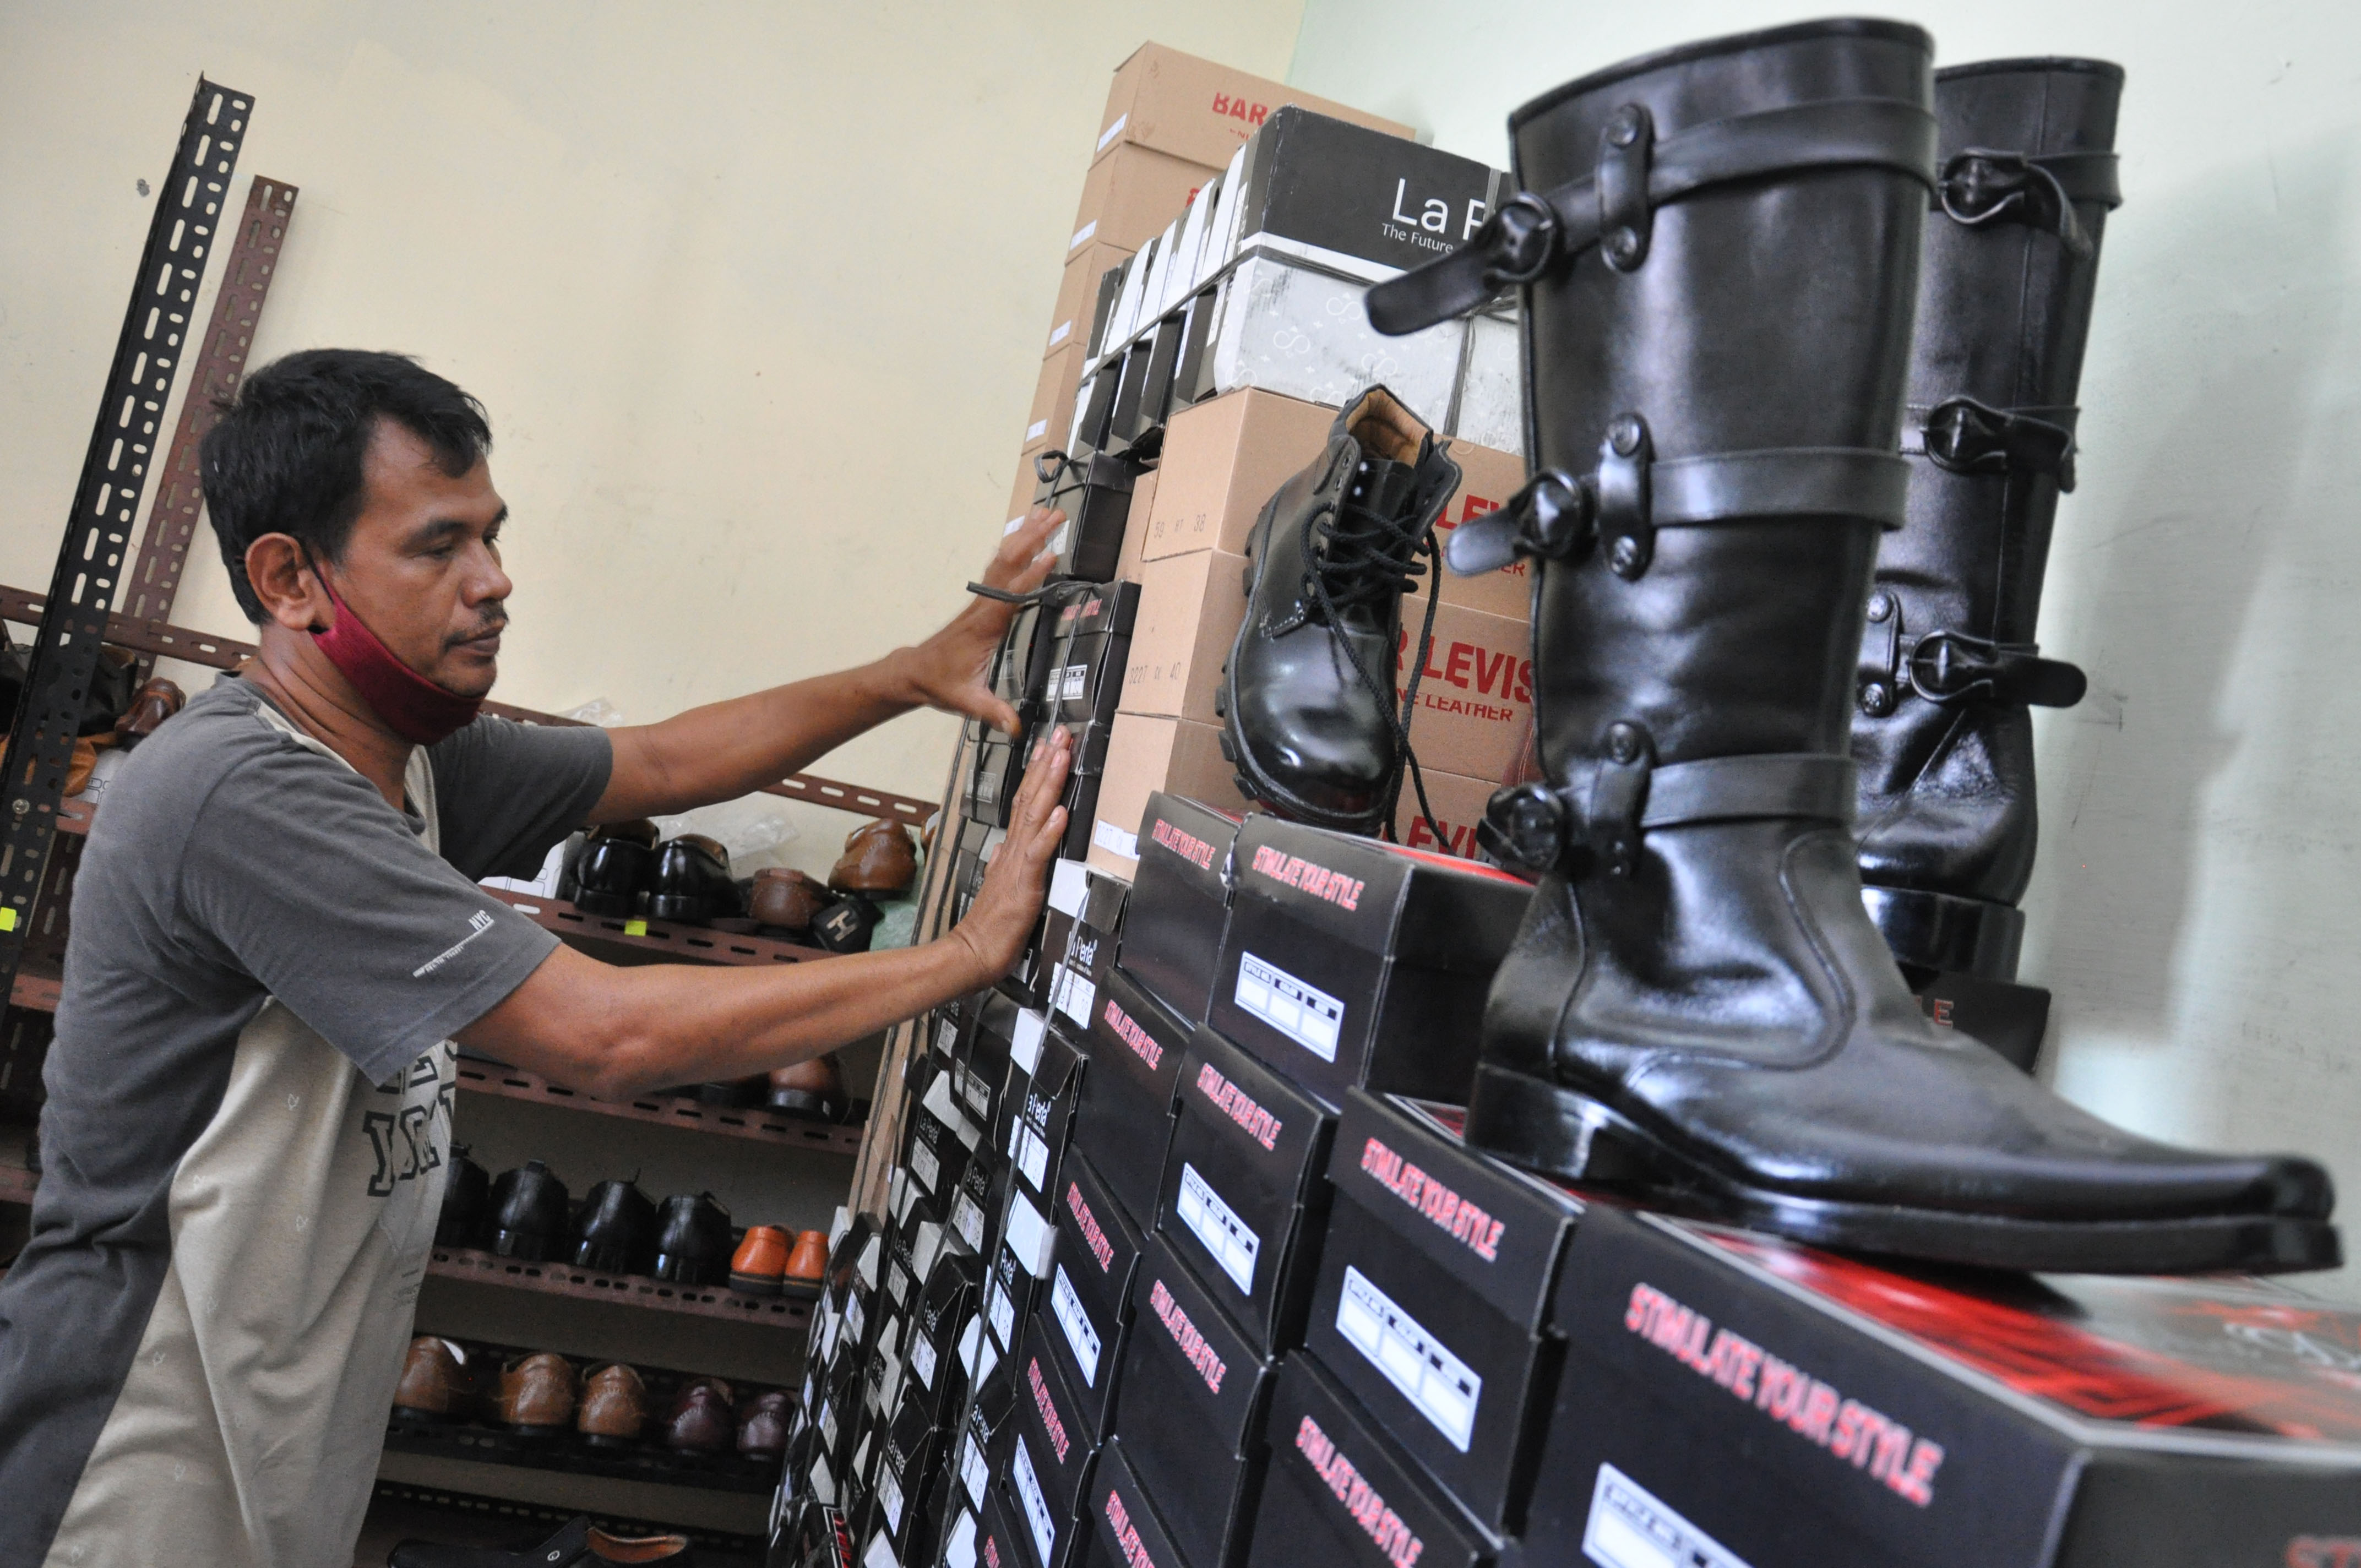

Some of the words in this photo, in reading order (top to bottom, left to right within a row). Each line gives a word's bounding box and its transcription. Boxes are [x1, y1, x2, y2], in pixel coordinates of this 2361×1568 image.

[1212, 92, 1268, 126] BAR
[1392, 178, 1448, 234] La
[1382, 223, 1406, 241] The
[1411, 232, 1454, 254] Future
[1422, 635, 1532, 703] LEVIS
[1425, 694, 1513, 722] LEATHER
[1252, 845, 1305, 886] STIMULATE
[1298, 862, 1331, 897] YOUR
[1324, 872, 1365, 911] STYLE
[469, 910, 491, 931] NYC
[1075, 936, 1094, 966] Perla
[1031, 1093, 1048, 1127] Perla
[1196, 1063, 1237, 1113] STIMULATE
[1230, 1090, 1256, 1129] YOUR
[1248, 1107, 1282, 1151] STYLE
[971, 1167, 985, 1196] Perla
[1361, 1137, 1427, 1208] STIMULATE
[1418, 1176, 1460, 1232] YOUR
[1451, 1200, 1505, 1262] STYLE
[1150, 1279, 1188, 1342] STIMULATE
[1179, 1319, 1204, 1365] YOUR
[1196, 1343, 1227, 1394] STYLE
[1625, 1282, 1763, 1401] STIMULATE
[1755, 1353, 1840, 1446] YOUR
[1831, 1398, 1945, 1507] STYLE
[1296, 1415, 1355, 1501] STIMULATE
[1345, 1472, 1384, 1536] YOUR
[1374, 1507, 1423, 1568] STYLE
